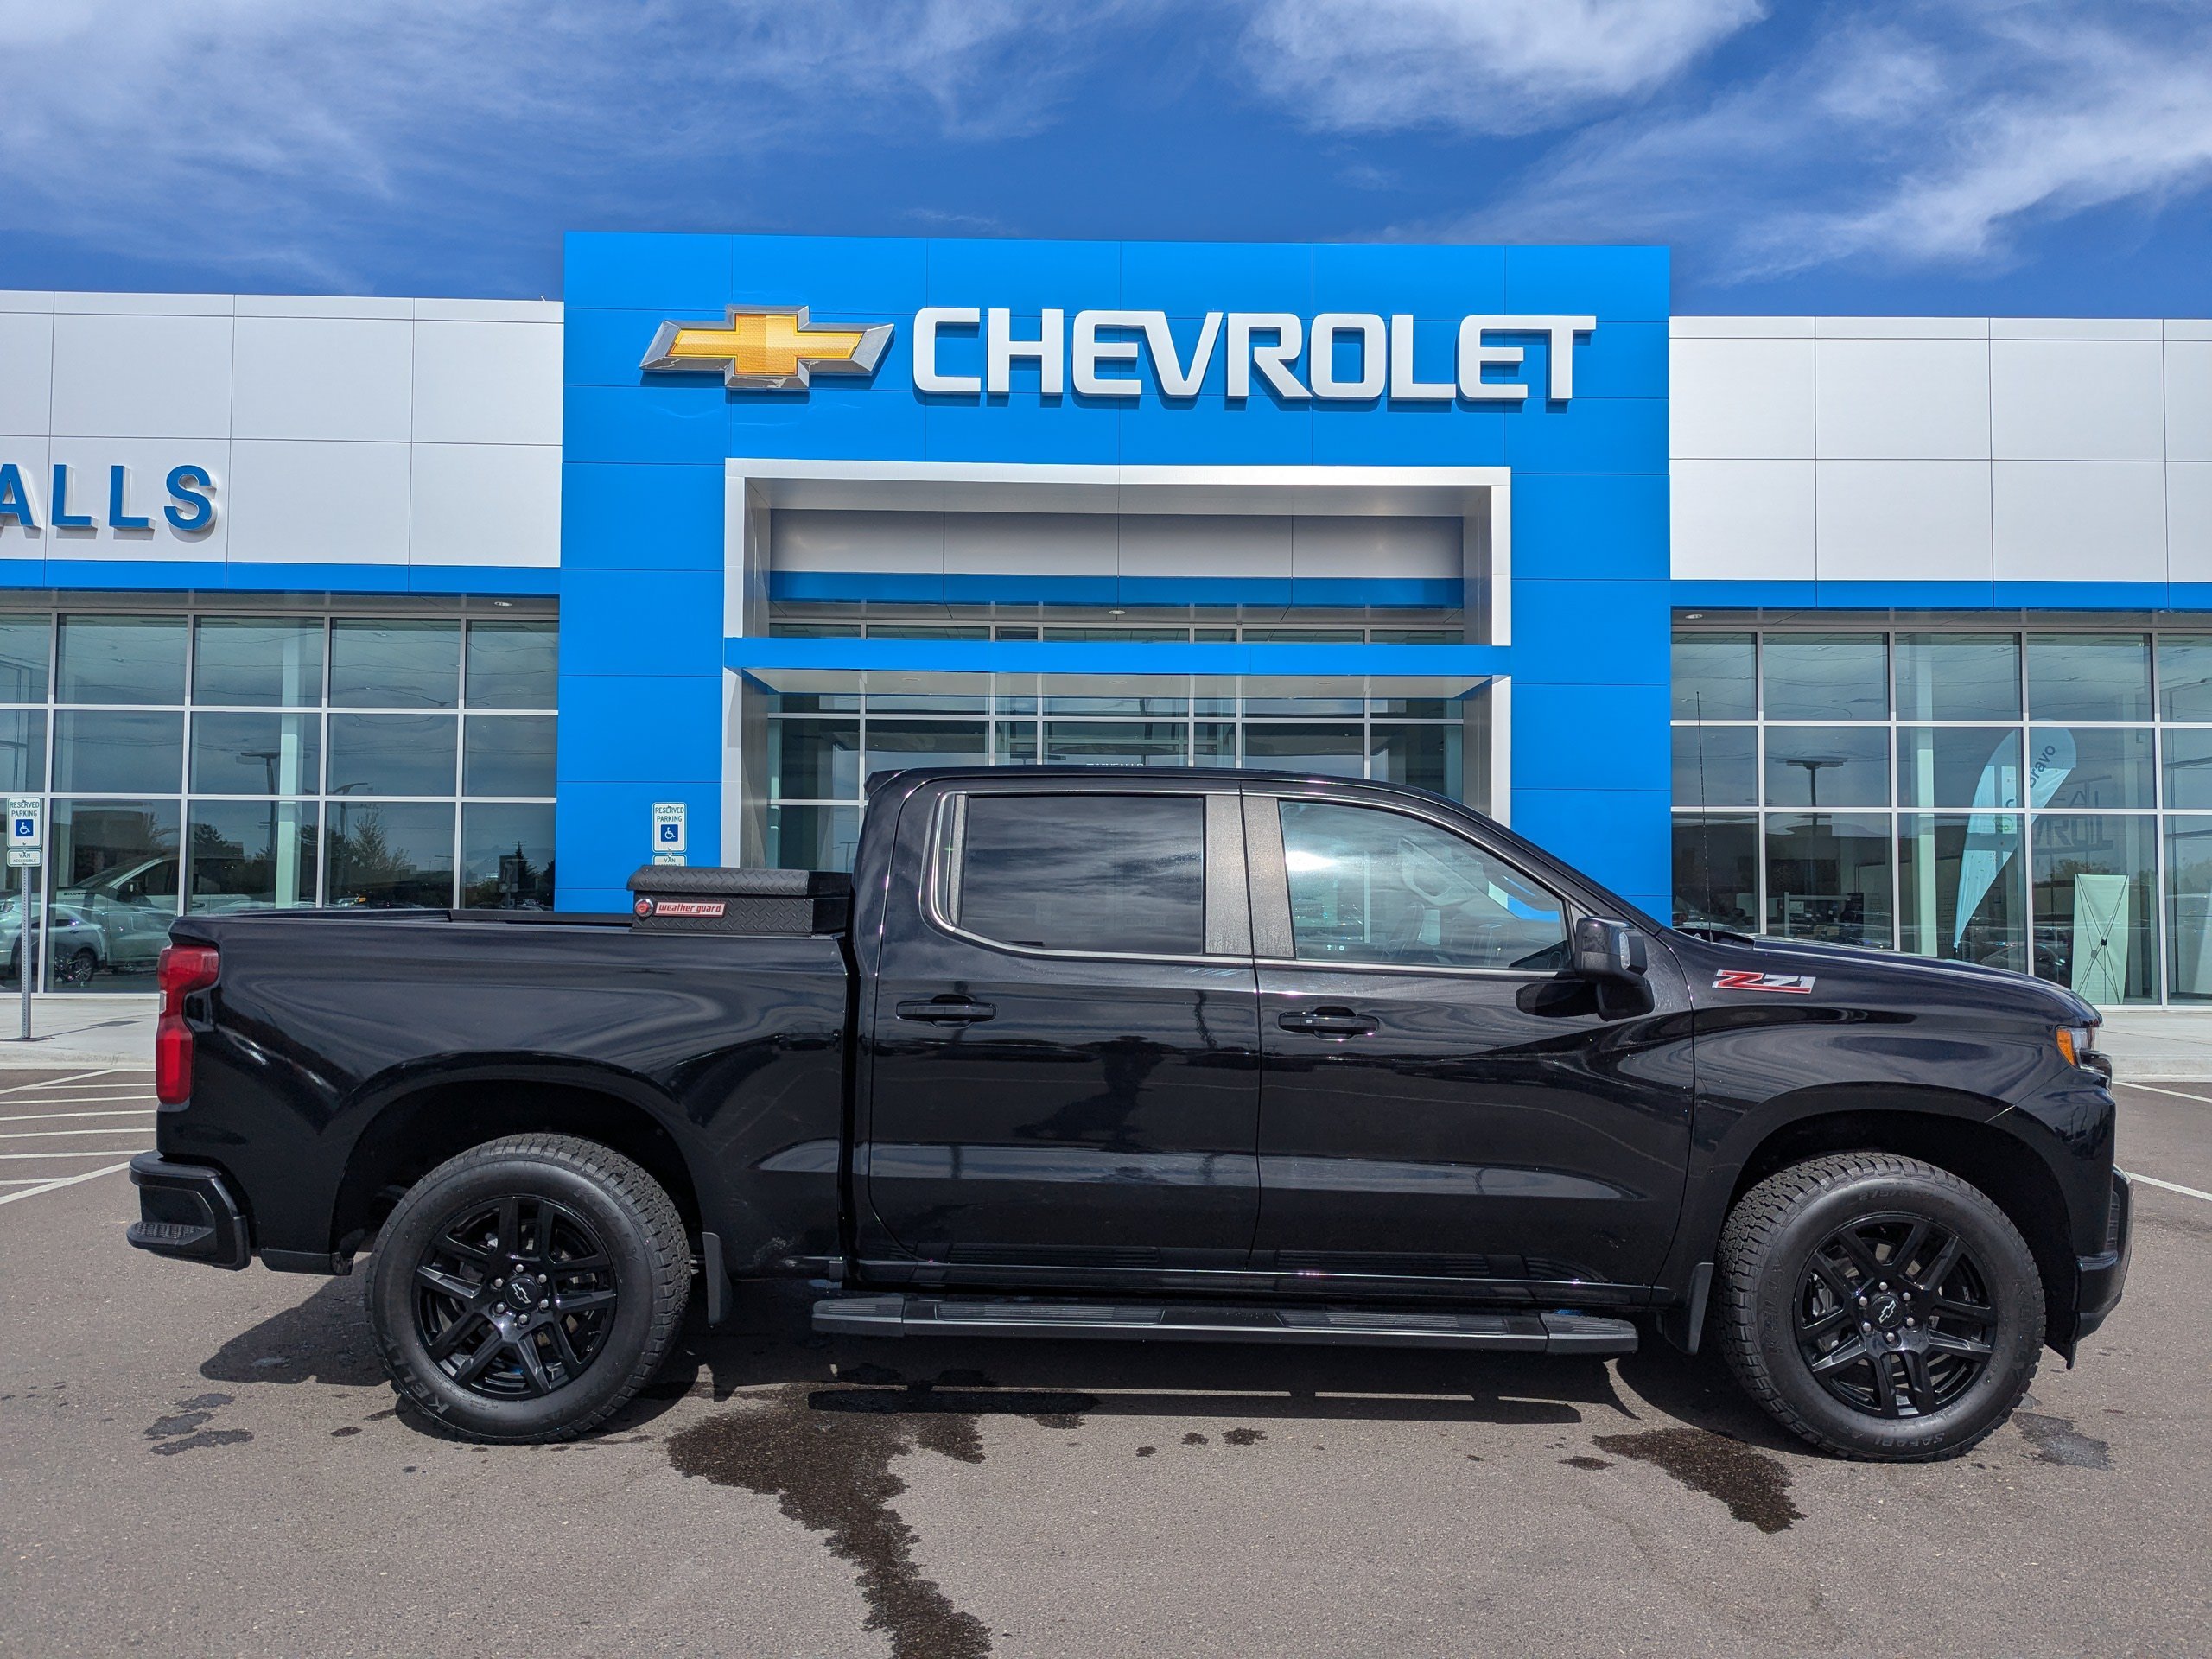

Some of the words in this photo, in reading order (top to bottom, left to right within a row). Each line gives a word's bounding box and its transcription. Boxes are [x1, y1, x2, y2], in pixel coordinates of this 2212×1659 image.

[912, 307, 1597, 404] CHEVROLET
[0, 463, 218, 532] ALLS
[658, 903, 695, 912] weather
[696, 904, 722, 913] guard
[1711, 969, 1816, 995] Z71
[382, 1333, 451, 1414] KELLY
